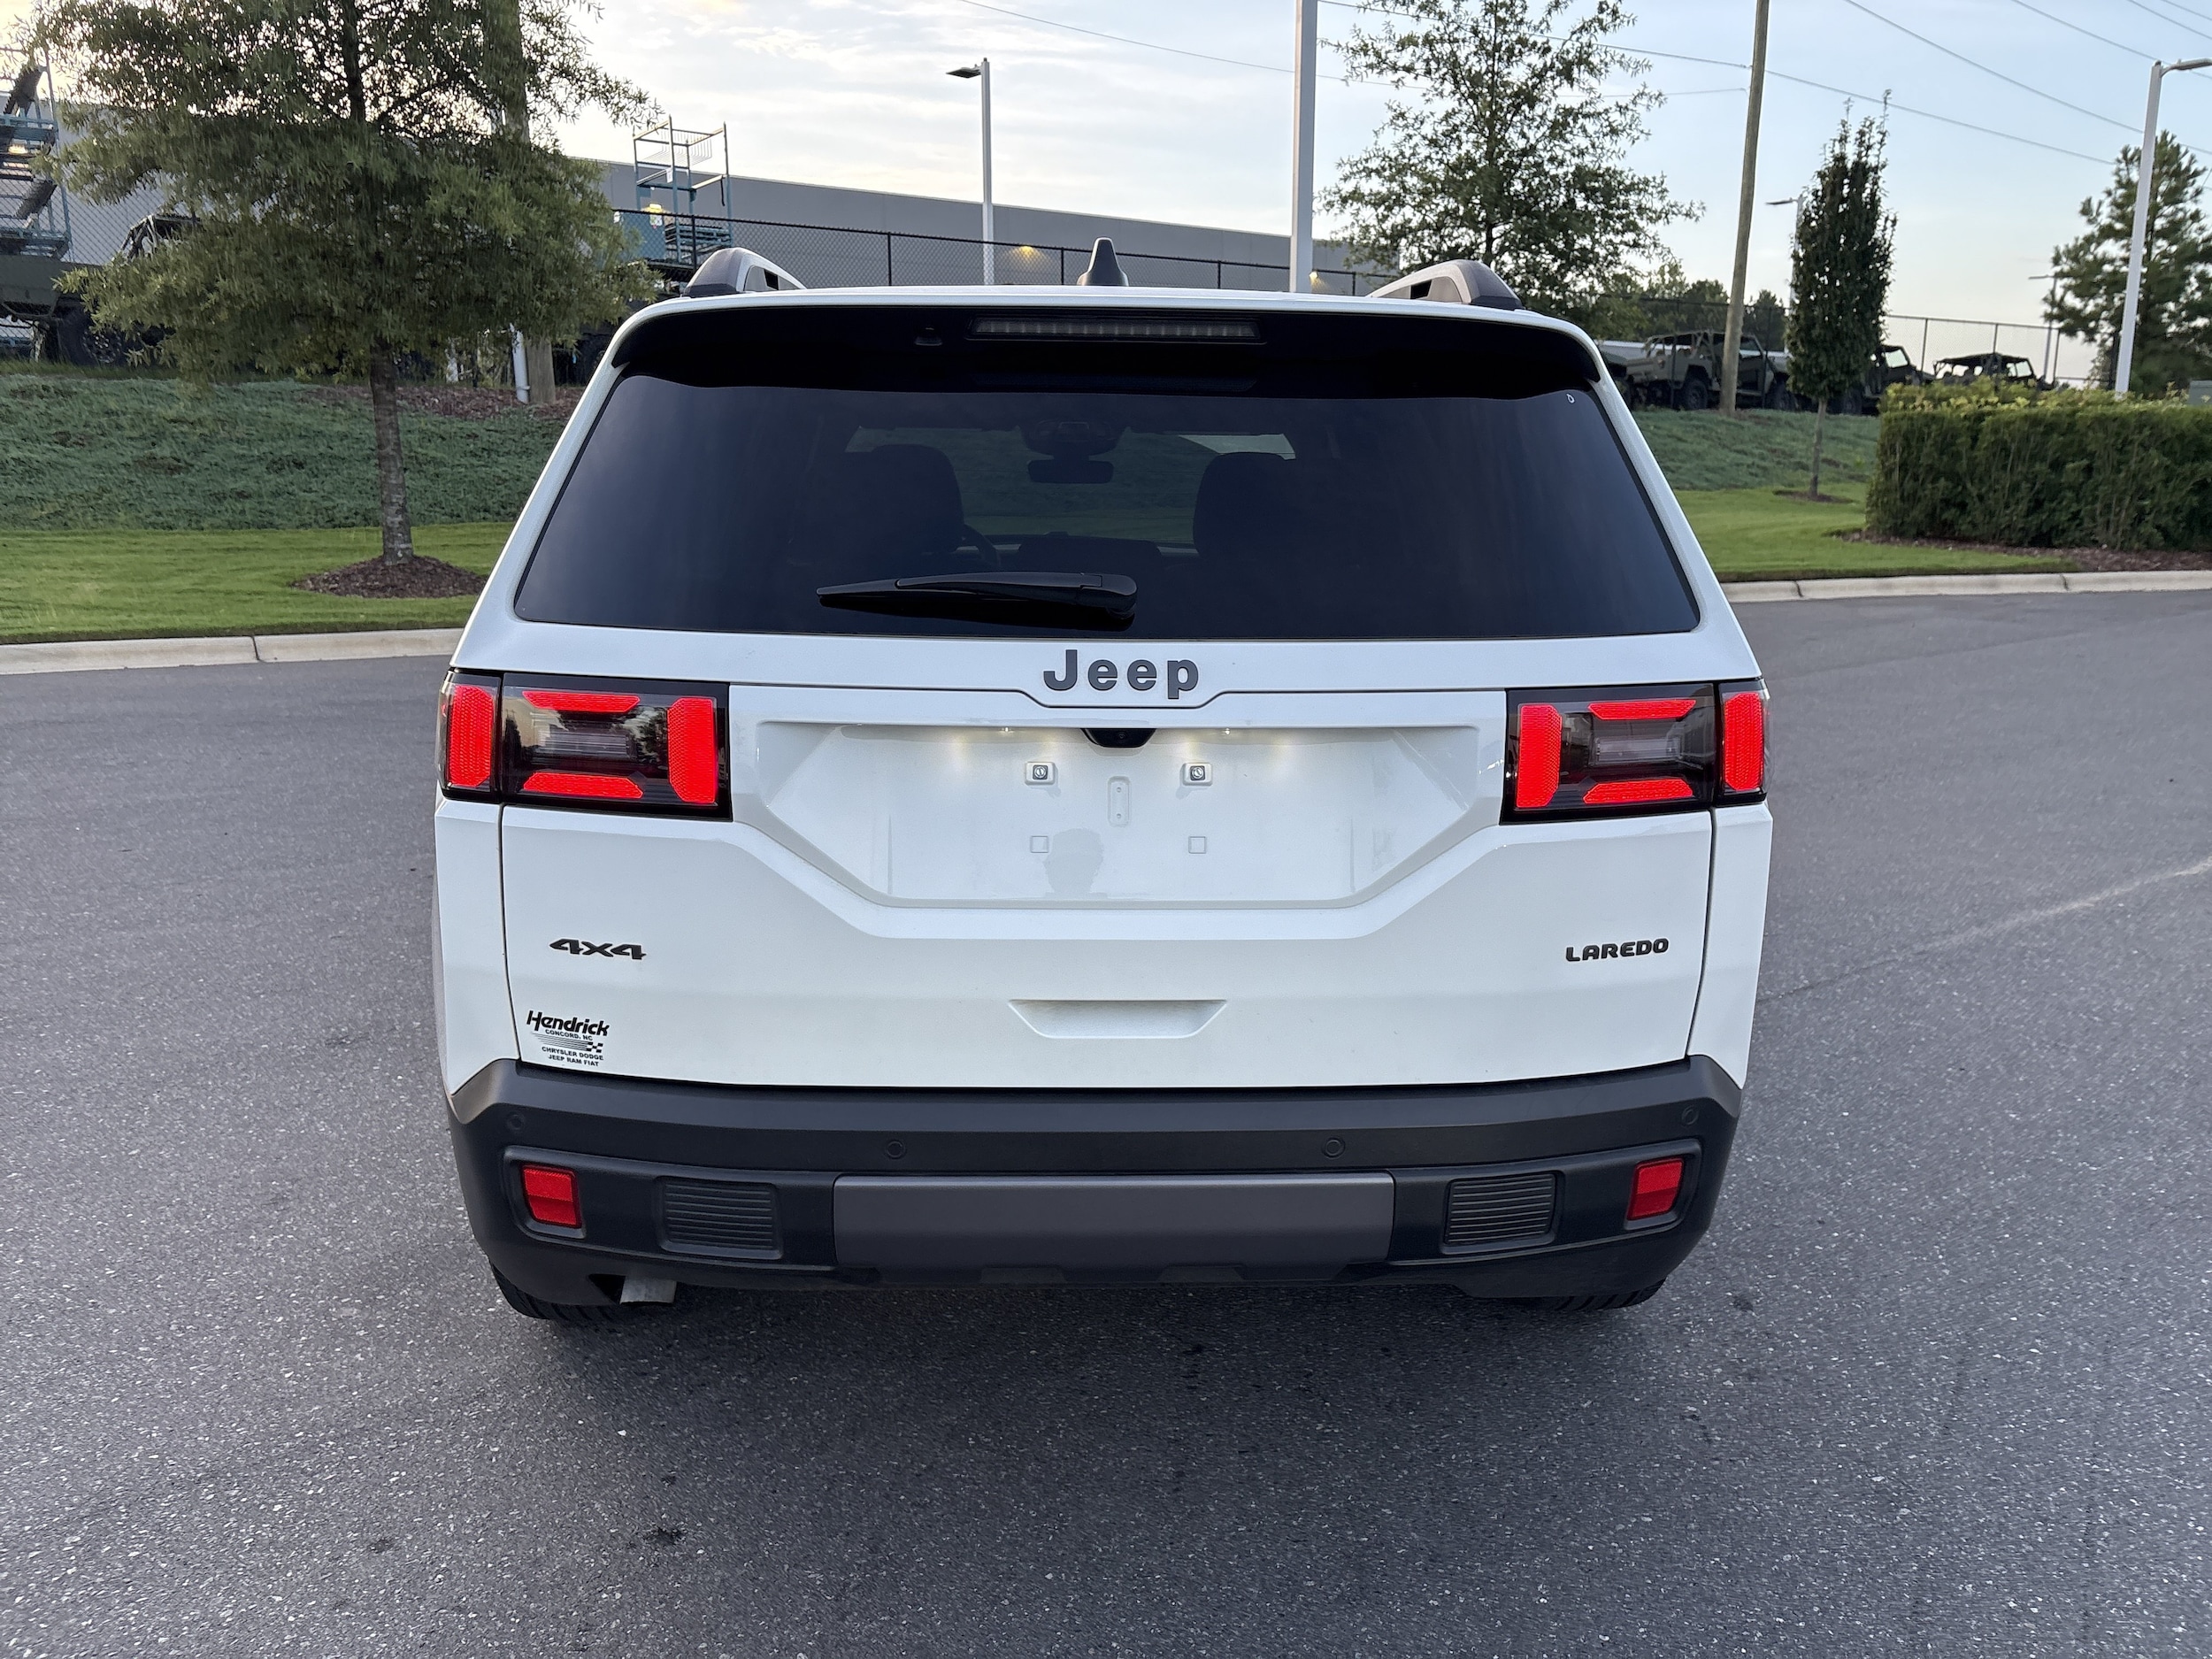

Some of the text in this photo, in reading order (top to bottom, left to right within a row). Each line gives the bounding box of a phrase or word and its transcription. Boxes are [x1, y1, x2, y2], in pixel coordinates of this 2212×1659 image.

[1043, 649, 1198, 699] Jeep
[1566, 938, 1669, 962] LAREDO
[526, 1010, 610, 1036] Hendrick
[545, 1029, 581, 1040] CONCORD,
[541, 1046, 603, 1061] CHRYSLER DODGE
